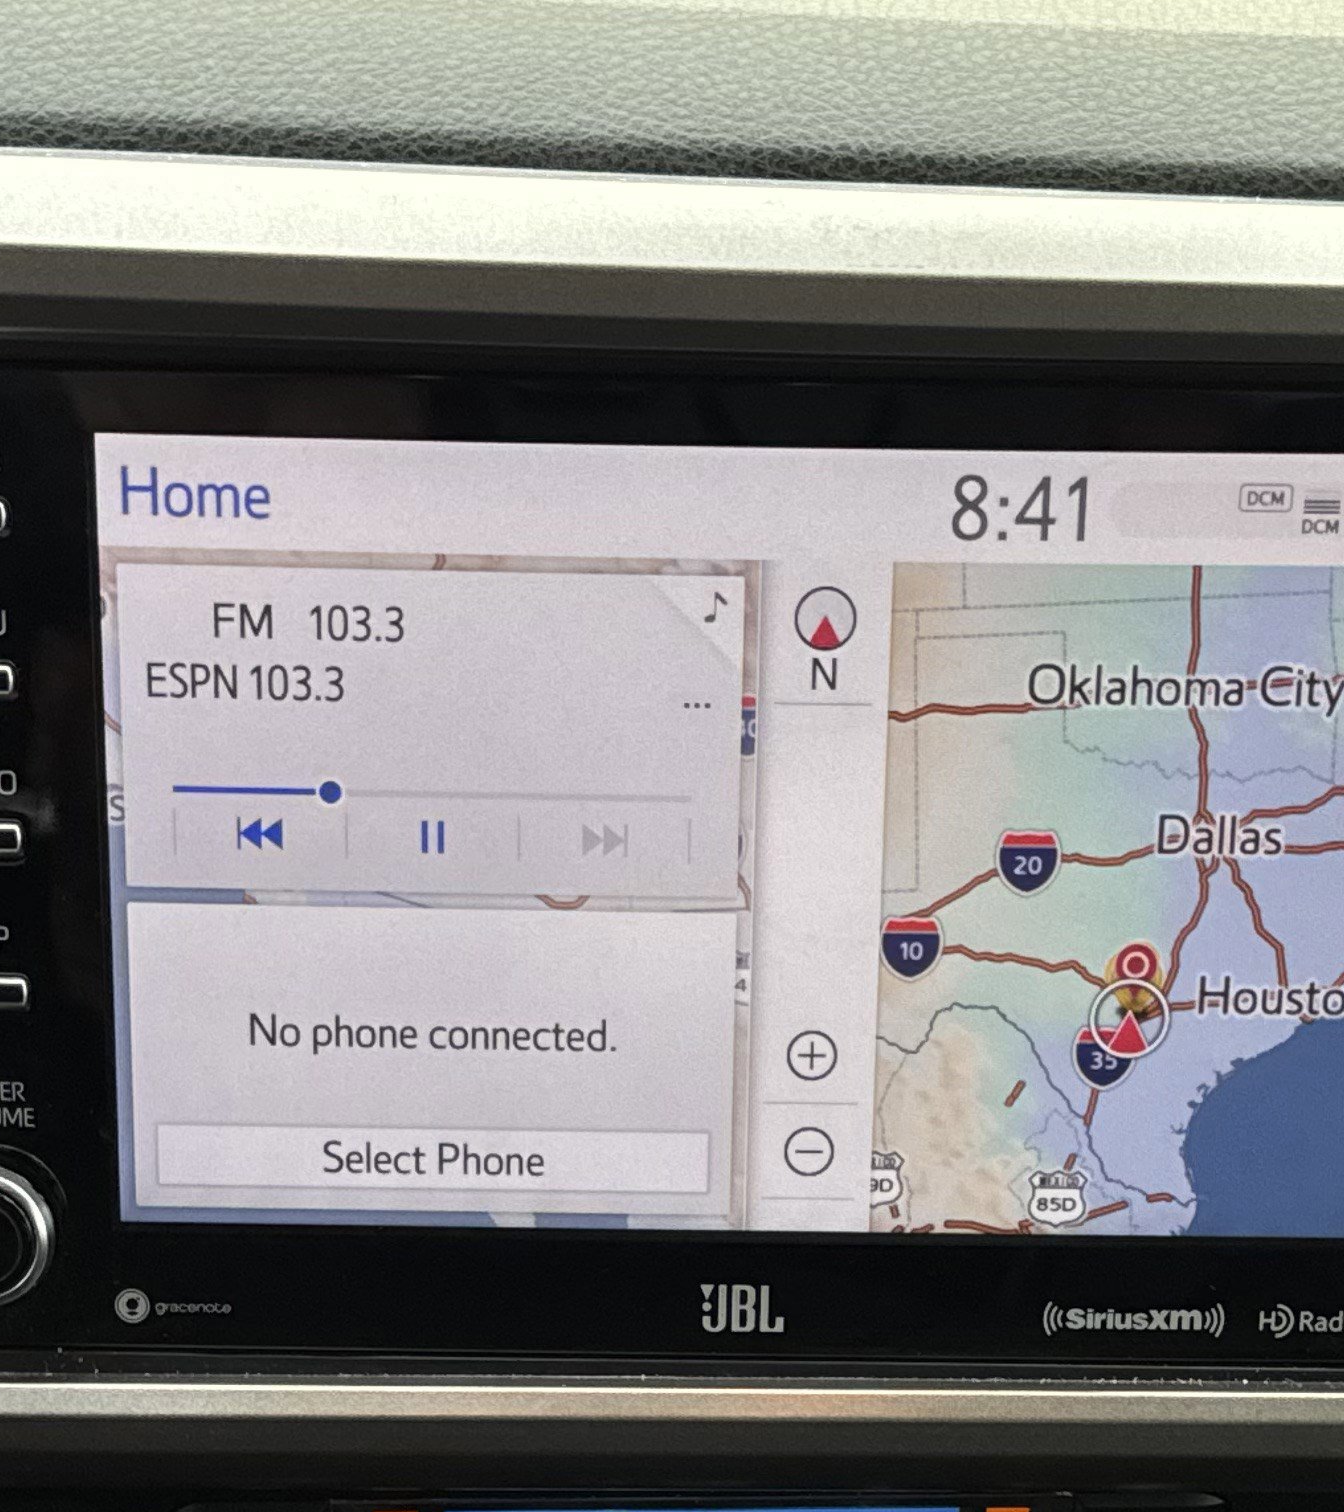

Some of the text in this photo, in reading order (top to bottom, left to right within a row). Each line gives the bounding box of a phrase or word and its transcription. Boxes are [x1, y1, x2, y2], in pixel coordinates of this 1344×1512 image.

[120, 465, 271, 520] Home
[951, 473, 1088, 542] 8:41
[1247, 490, 1285, 506] DCM
[1301, 518, 1340, 534] DCM
[213, 602, 405, 643] FM 103.3
[146, 661, 345, 703] ESPN 103.3
[811, 657, 838, 691] N
[1027, 663, 1245, 707] Oklahoma
[1157, 814, 1283, 856] Dallas
[1013, 855, 1043, 875] 20
[900, 941, 924, 961] 10
[249, 1012, 617, 1056] No phone connected.
[1090, 1051, 1118, 1071] 35
[323, 1139, 545, 1177] Select Phone
[1036, 1197, 1077, 1212] 85D
[700, 1284, 785, 1333] JBL
